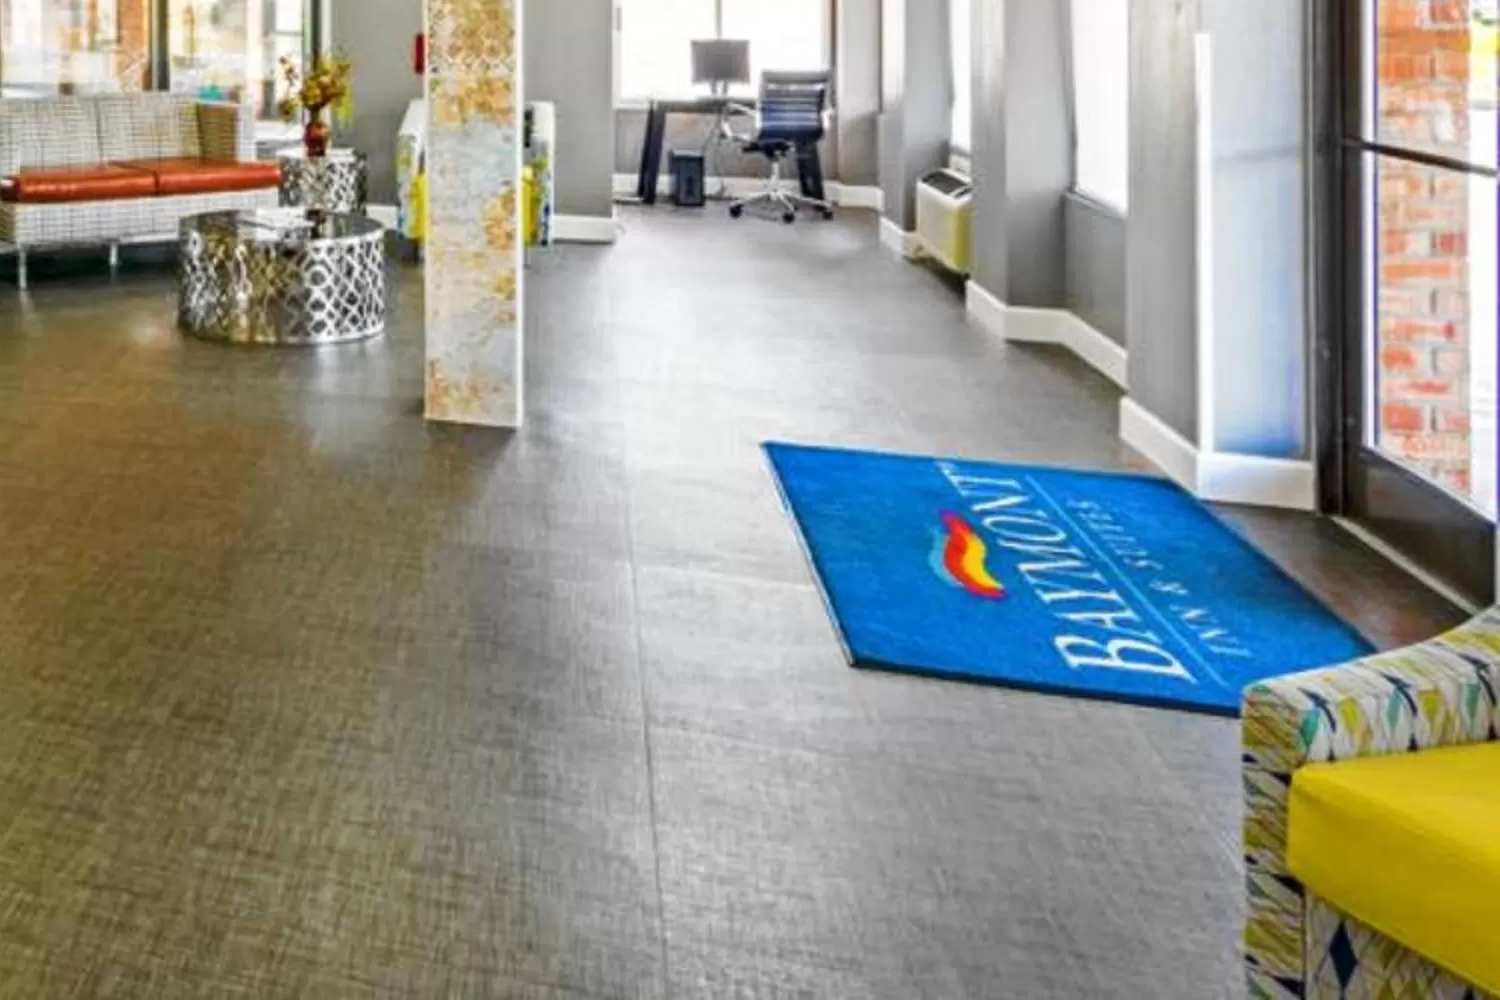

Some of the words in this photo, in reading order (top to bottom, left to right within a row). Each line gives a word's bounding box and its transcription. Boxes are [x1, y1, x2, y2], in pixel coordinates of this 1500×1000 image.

[1065, 499, 1165, 571] SUITES
[942, 467, 1199, 685] BAYMONT
[1169, 603, 1253, 658] INN
